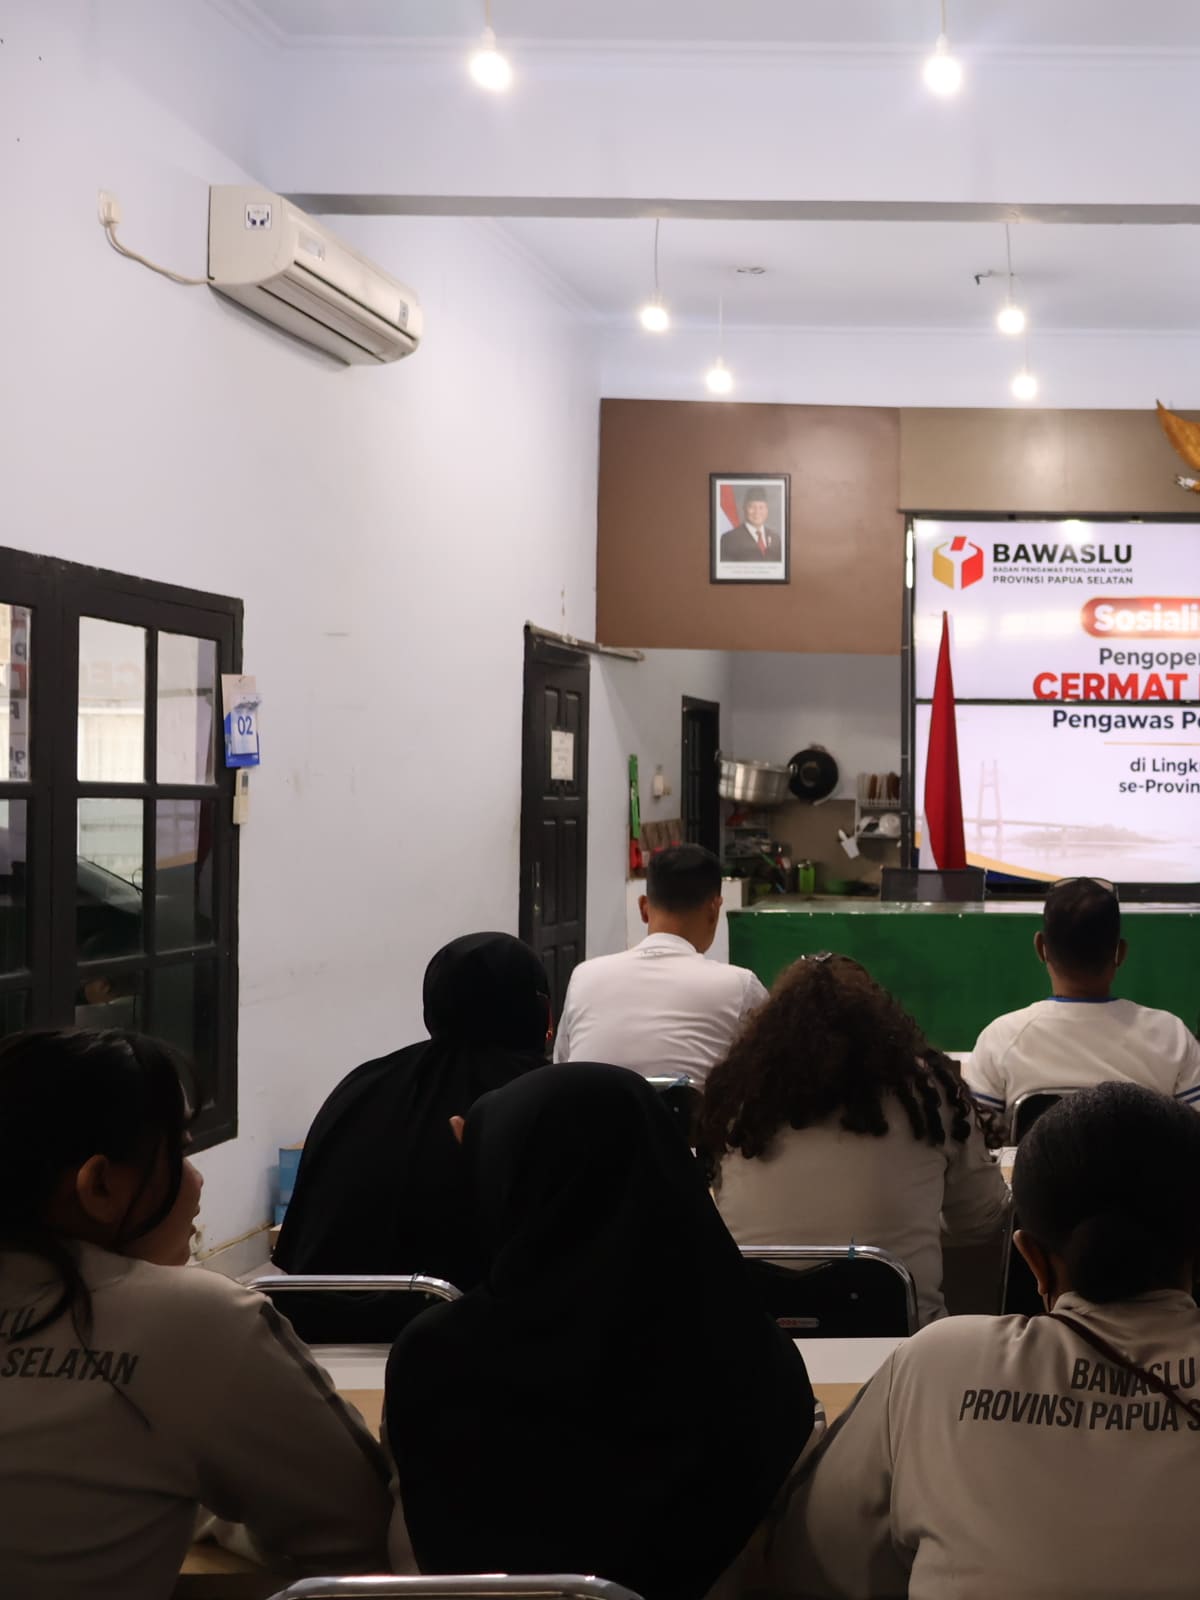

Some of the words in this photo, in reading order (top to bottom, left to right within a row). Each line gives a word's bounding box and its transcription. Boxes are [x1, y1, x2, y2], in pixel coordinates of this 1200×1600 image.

[993, 543, 1133, 565] BAWASLU
[992, 575, 1045, 585] PROVINSI
[1047, 575, 1084, 585] PAPUA
[1086, 576, 1134, 586] SELATAN
[1033, 672, 1188, 702] CERMAT
[237, 715, 254, 736] 02
[1052, 709, 1174, 734] Pengawas
[1130, 757, 1147, 773] di
[1, 1346, 140, 1385] SELATAN
[958, 1389, 1083, 1429] PROVINSI
[1089, 1402, 1180, 1432] PAPUA
